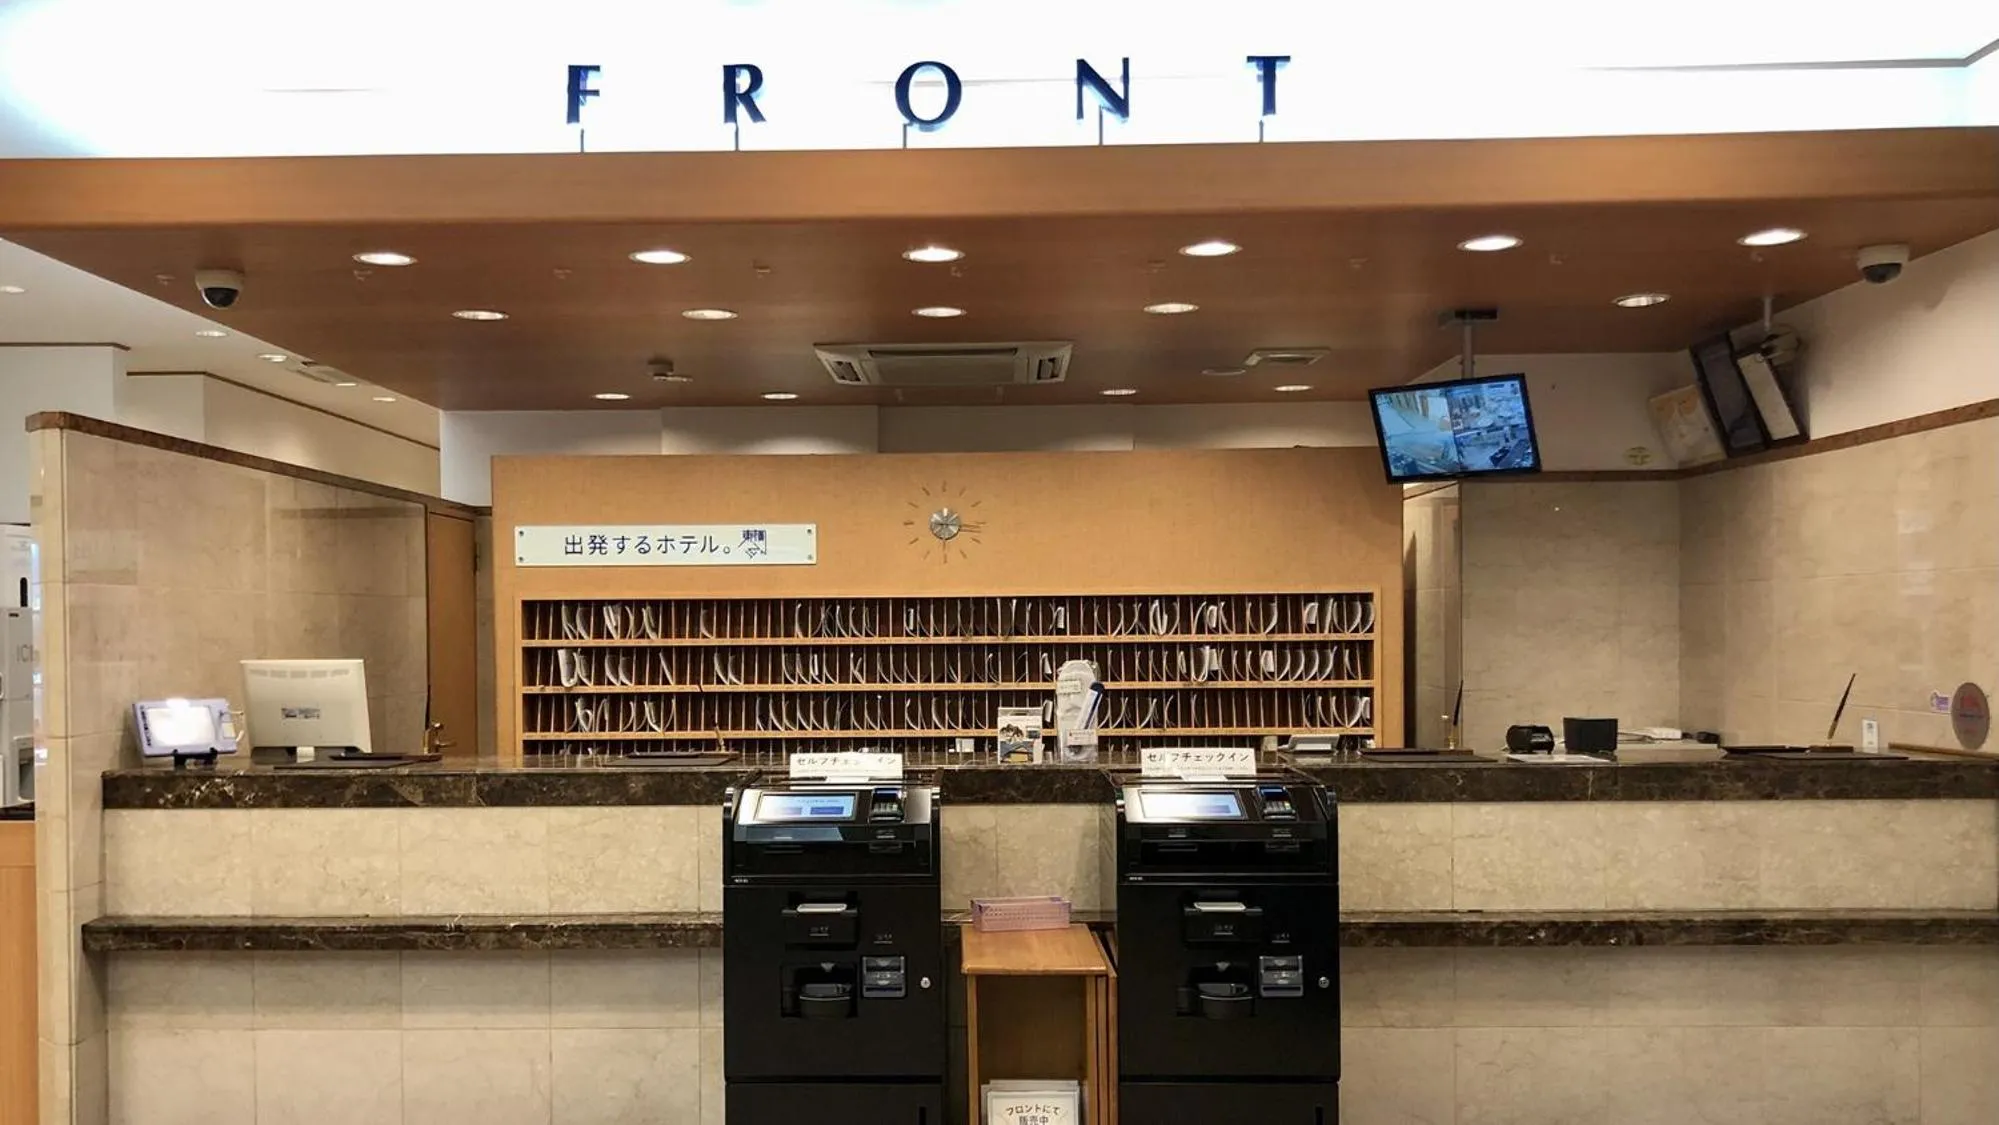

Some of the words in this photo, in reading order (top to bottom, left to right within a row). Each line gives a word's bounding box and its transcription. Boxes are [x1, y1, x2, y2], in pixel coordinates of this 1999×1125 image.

[567, 55, 1291, 126] FRONT
[564, 534, 731, 556] 出発するホテル。
[797, 757, 896, 766] セルフチェッイン
[1005, 1104, 1061, 1116] フロントにて
